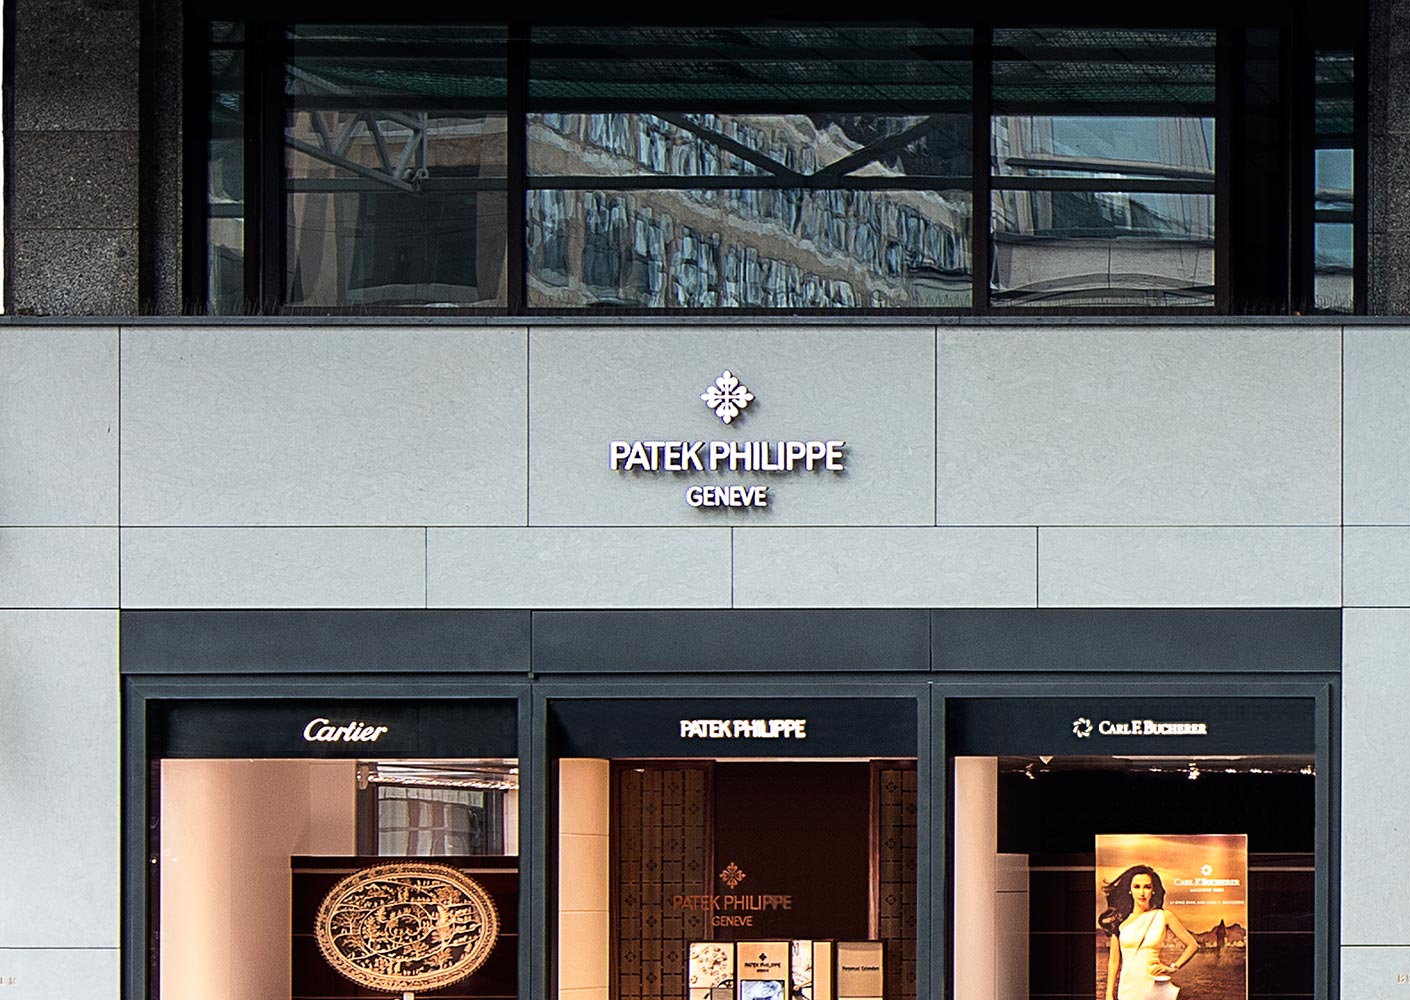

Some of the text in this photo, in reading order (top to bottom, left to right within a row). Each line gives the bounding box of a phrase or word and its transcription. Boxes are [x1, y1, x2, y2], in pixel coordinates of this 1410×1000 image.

[609, 441, 846, 472] PATEK PHILIPPE
[686, 486, 768, 508] GENEVE
[303, 718, 388, 742] Cartier
[680, 719, 807, 738] PATEK PHILIPPE
[1098, 719, 1208, 735] CARL F. BUCHERER
[672, 895, 792, 911] PATEK PHILIPPE
[711, 915, 753, 927] GENEVE
